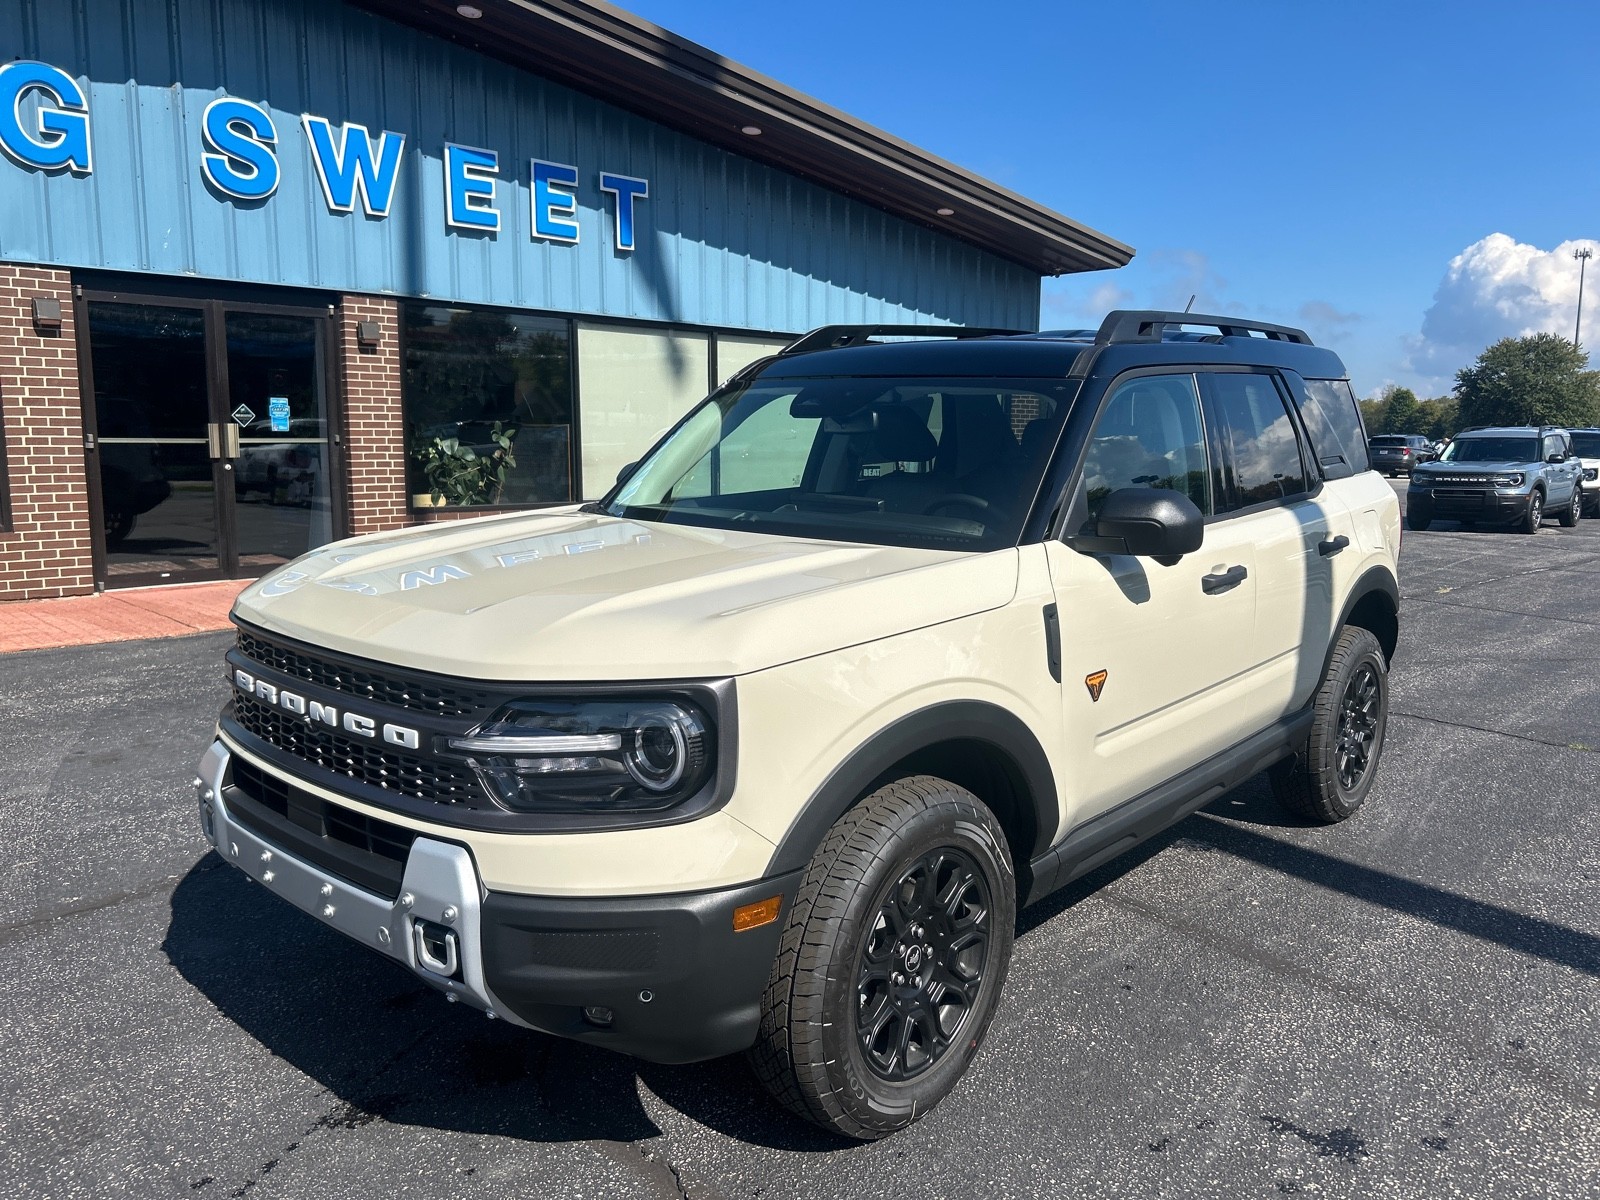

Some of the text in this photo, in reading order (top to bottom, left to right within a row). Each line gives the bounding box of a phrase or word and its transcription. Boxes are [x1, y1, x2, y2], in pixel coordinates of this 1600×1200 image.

[0, 60, 648, 251] G SWEET
[863, 468, 880, 477] BEAT
[236, 669, 419, 750] BRONCO
